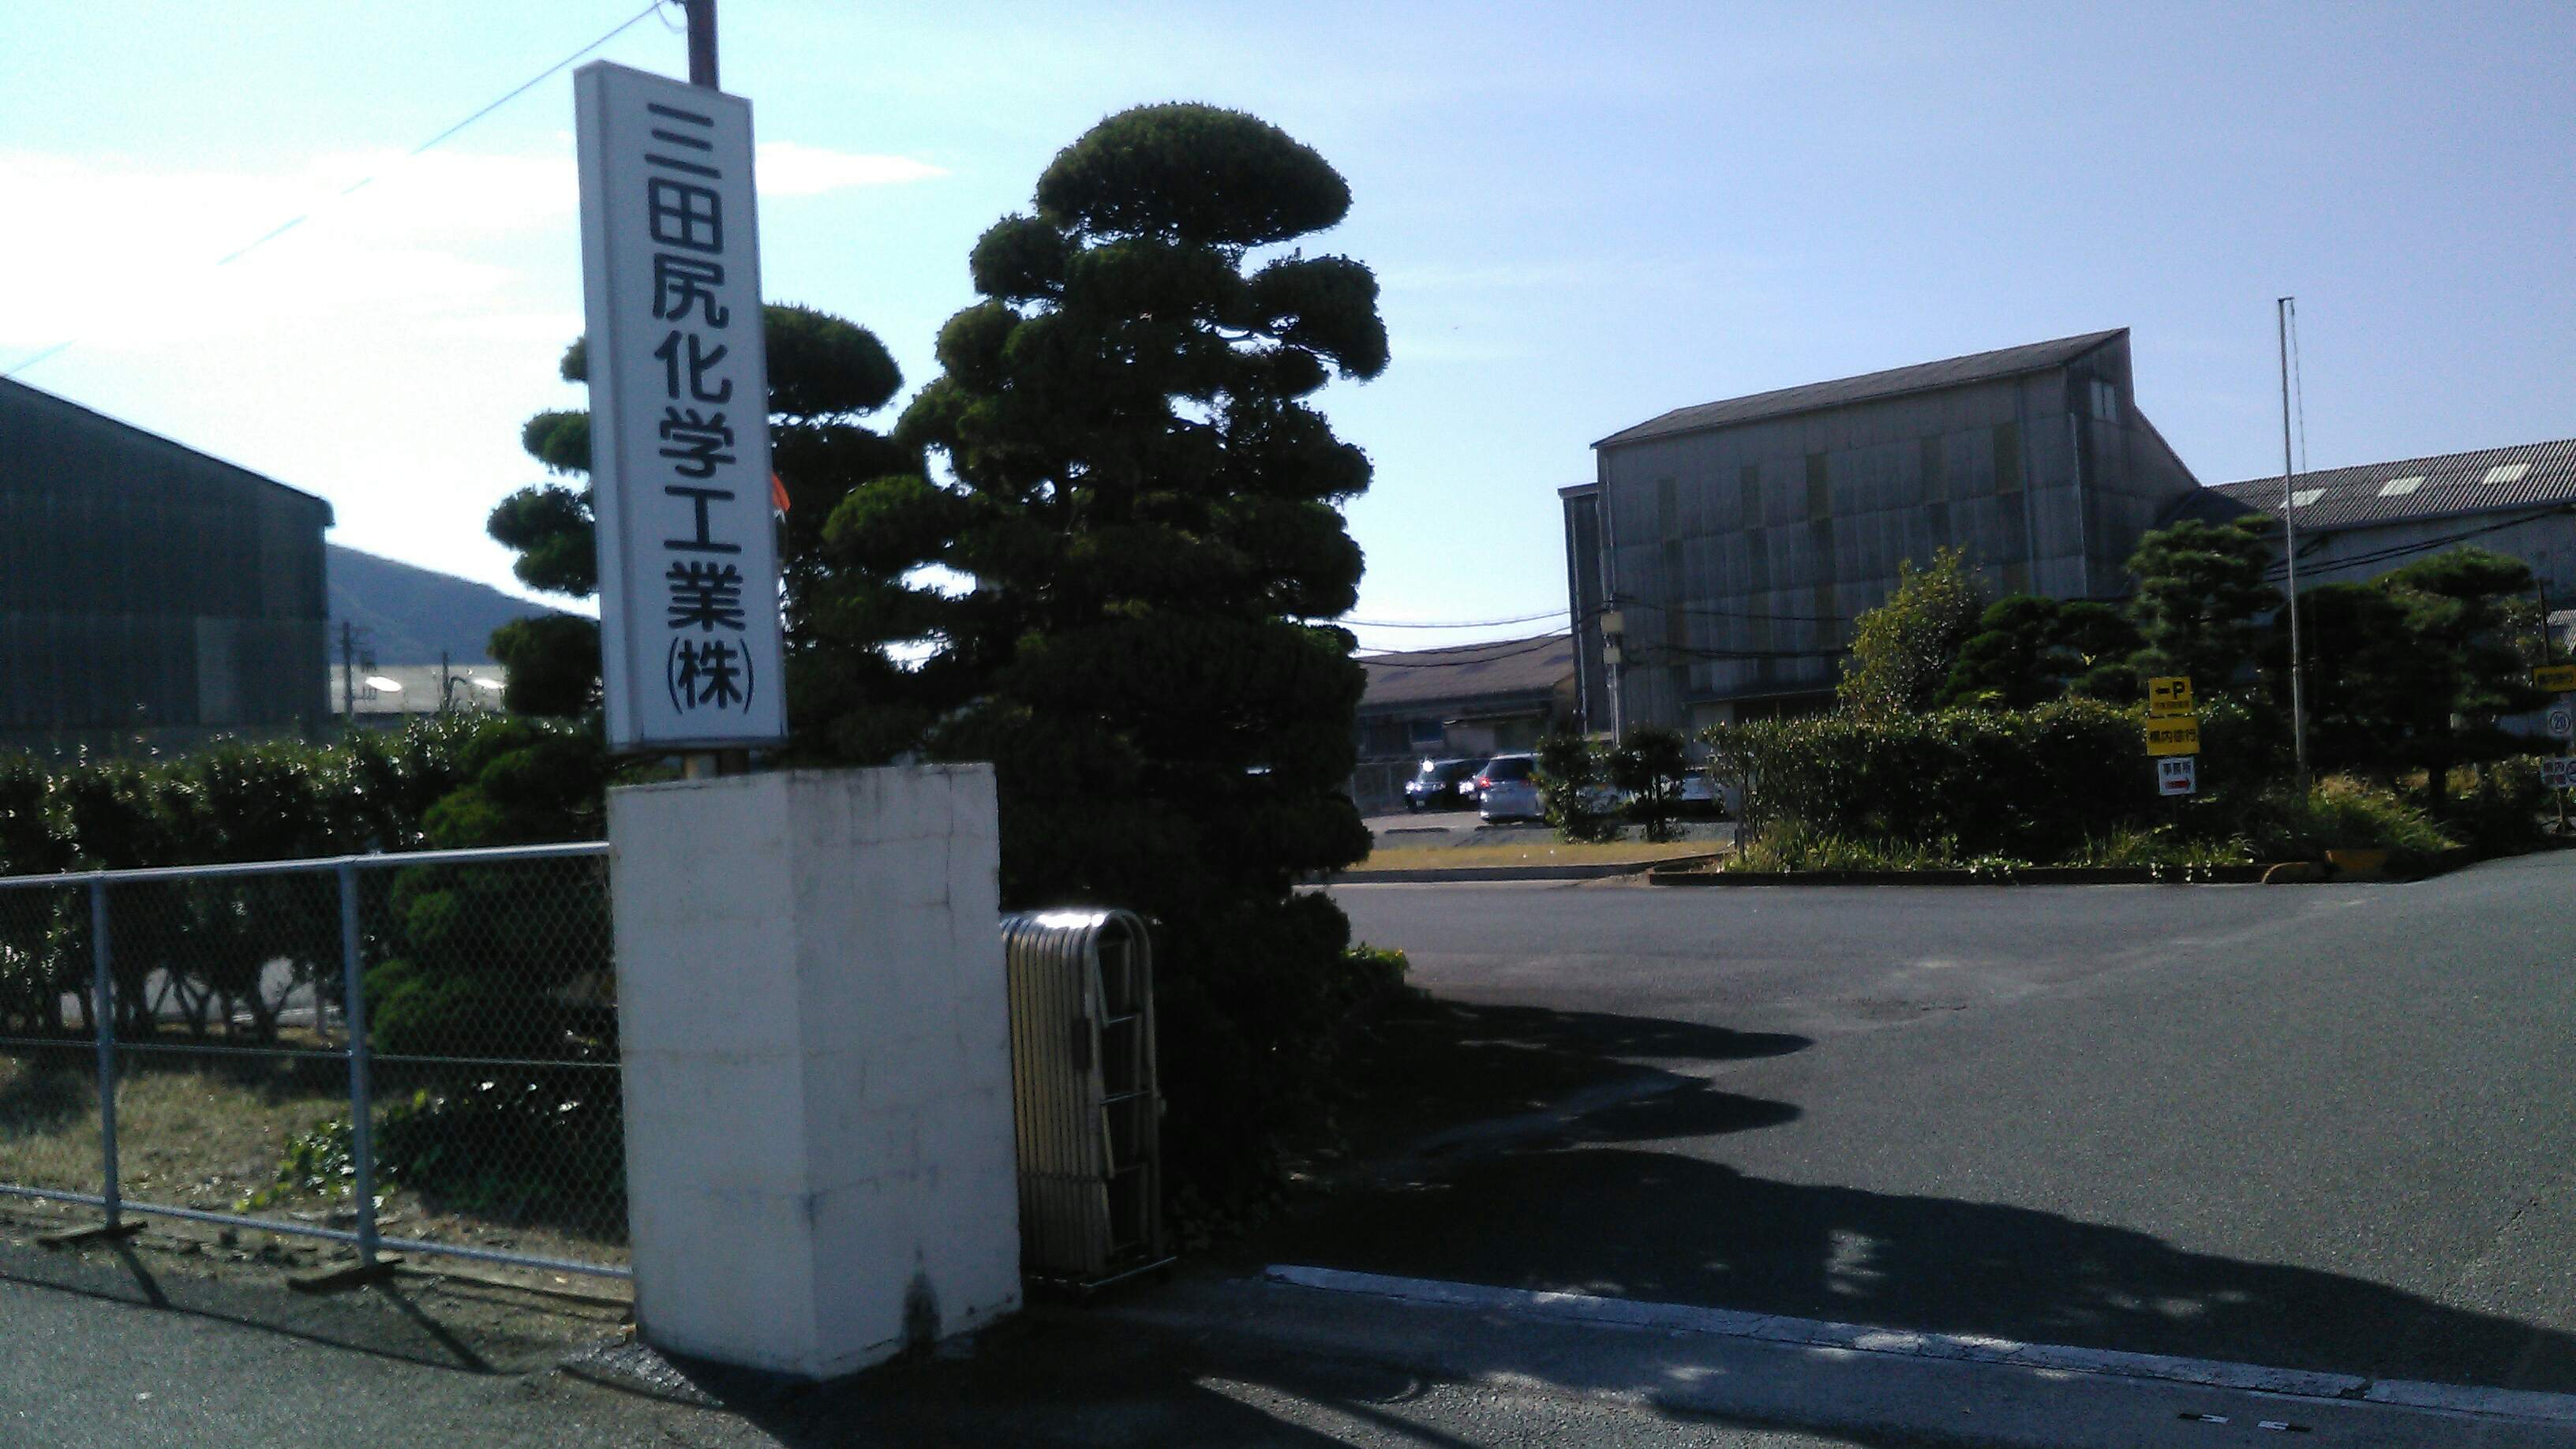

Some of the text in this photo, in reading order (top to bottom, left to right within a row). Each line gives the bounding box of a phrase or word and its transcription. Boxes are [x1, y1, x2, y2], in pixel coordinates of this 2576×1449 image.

[644, 101, 754, 717] 三田尻化学工業(株)
